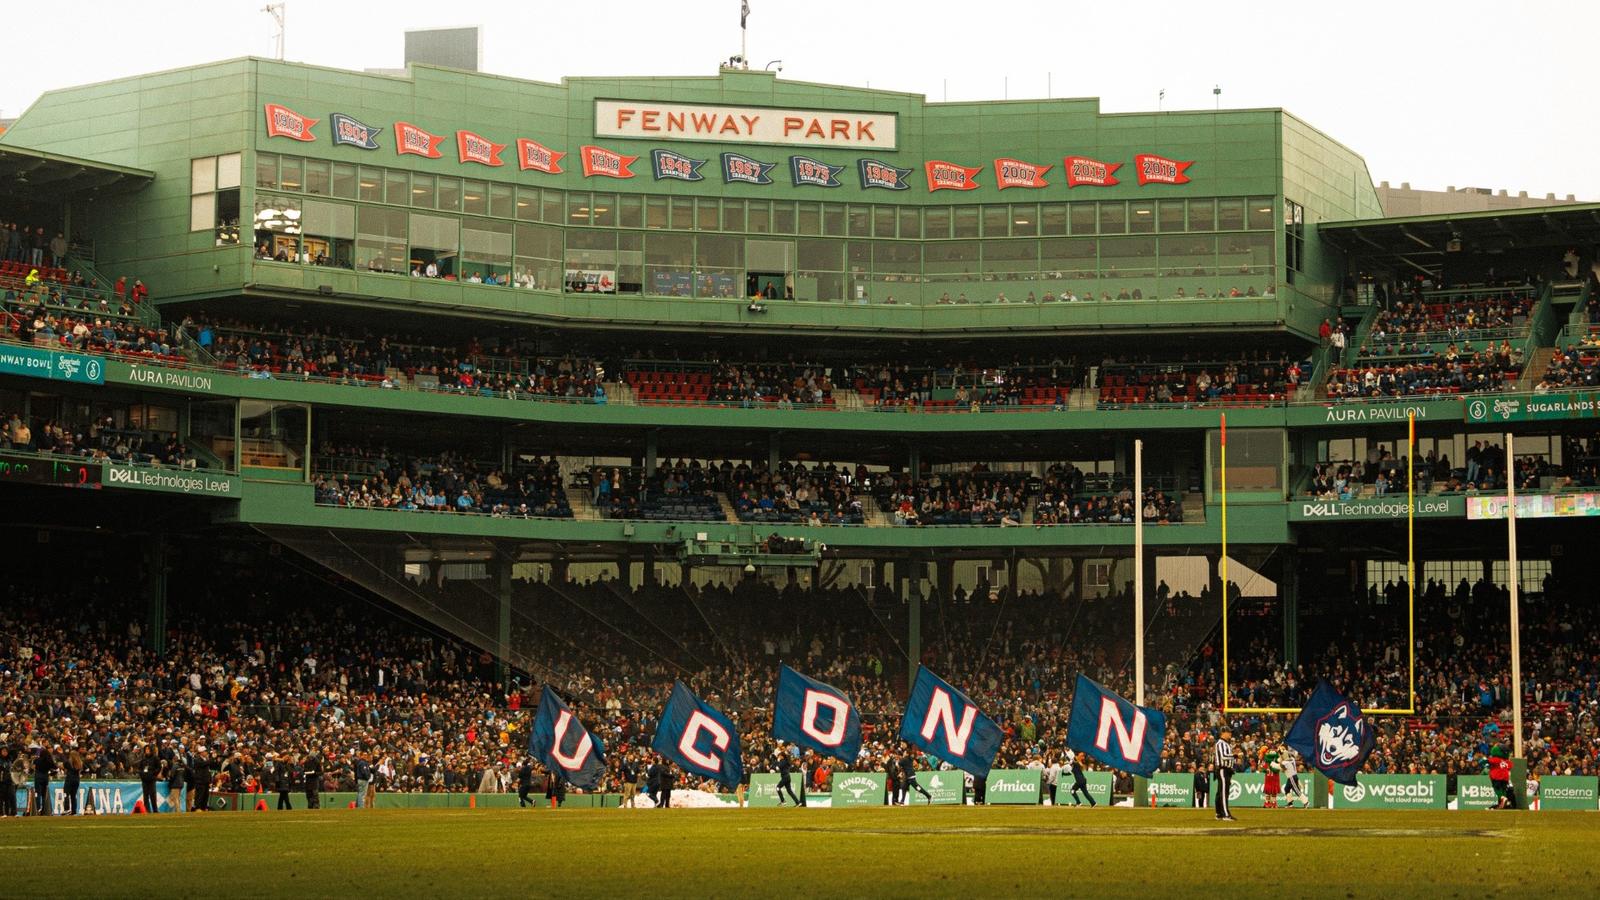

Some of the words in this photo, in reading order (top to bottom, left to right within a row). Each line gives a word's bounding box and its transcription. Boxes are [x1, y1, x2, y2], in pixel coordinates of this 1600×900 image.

[617, 109, 760, 135] FENWAY
[784, 116, 875, 141] PARK
[404, 129, 430, 150] 1912
[591, 153, 620, 170] 1918
[660, 157, 692, 175] 1946
[1143, 162, 1177, 178] 2018
[798, 163, 830, 181] 1975
[933, 168, 966, 183] 2004
[1002, 166, 1036, 181] 2007
[1073, 164, 1107, 179] 2013
[26, 358, 51, 370] BOWL
[166, 372, 212, 390] PAVILION
[1370, 406, 1426, 420] PAVILION
[1526, 401, 1594, 413] SUGARLANDS
[109, 468, 141, 484] DELL
[141, 471, 203, 492] Technologies
[205, 479, 230, 492] Level
[1303, 503, 1339, 517] DELL
[1338, 502, 1415, 518] Technologies
[1418, 500, 1449, 513] Level
[802, 688, 850, 748] O
[920, 686, 978, 757] N
[1095, 696, 1147, 763] N
[551, 709, 593, 771] U
[679, 709, 731, 773] C
[990, 778, 1036, 792] Amica
[1368, 780, 1434, 796] wasabi
[1544, 787, 1593, 797] moderna
